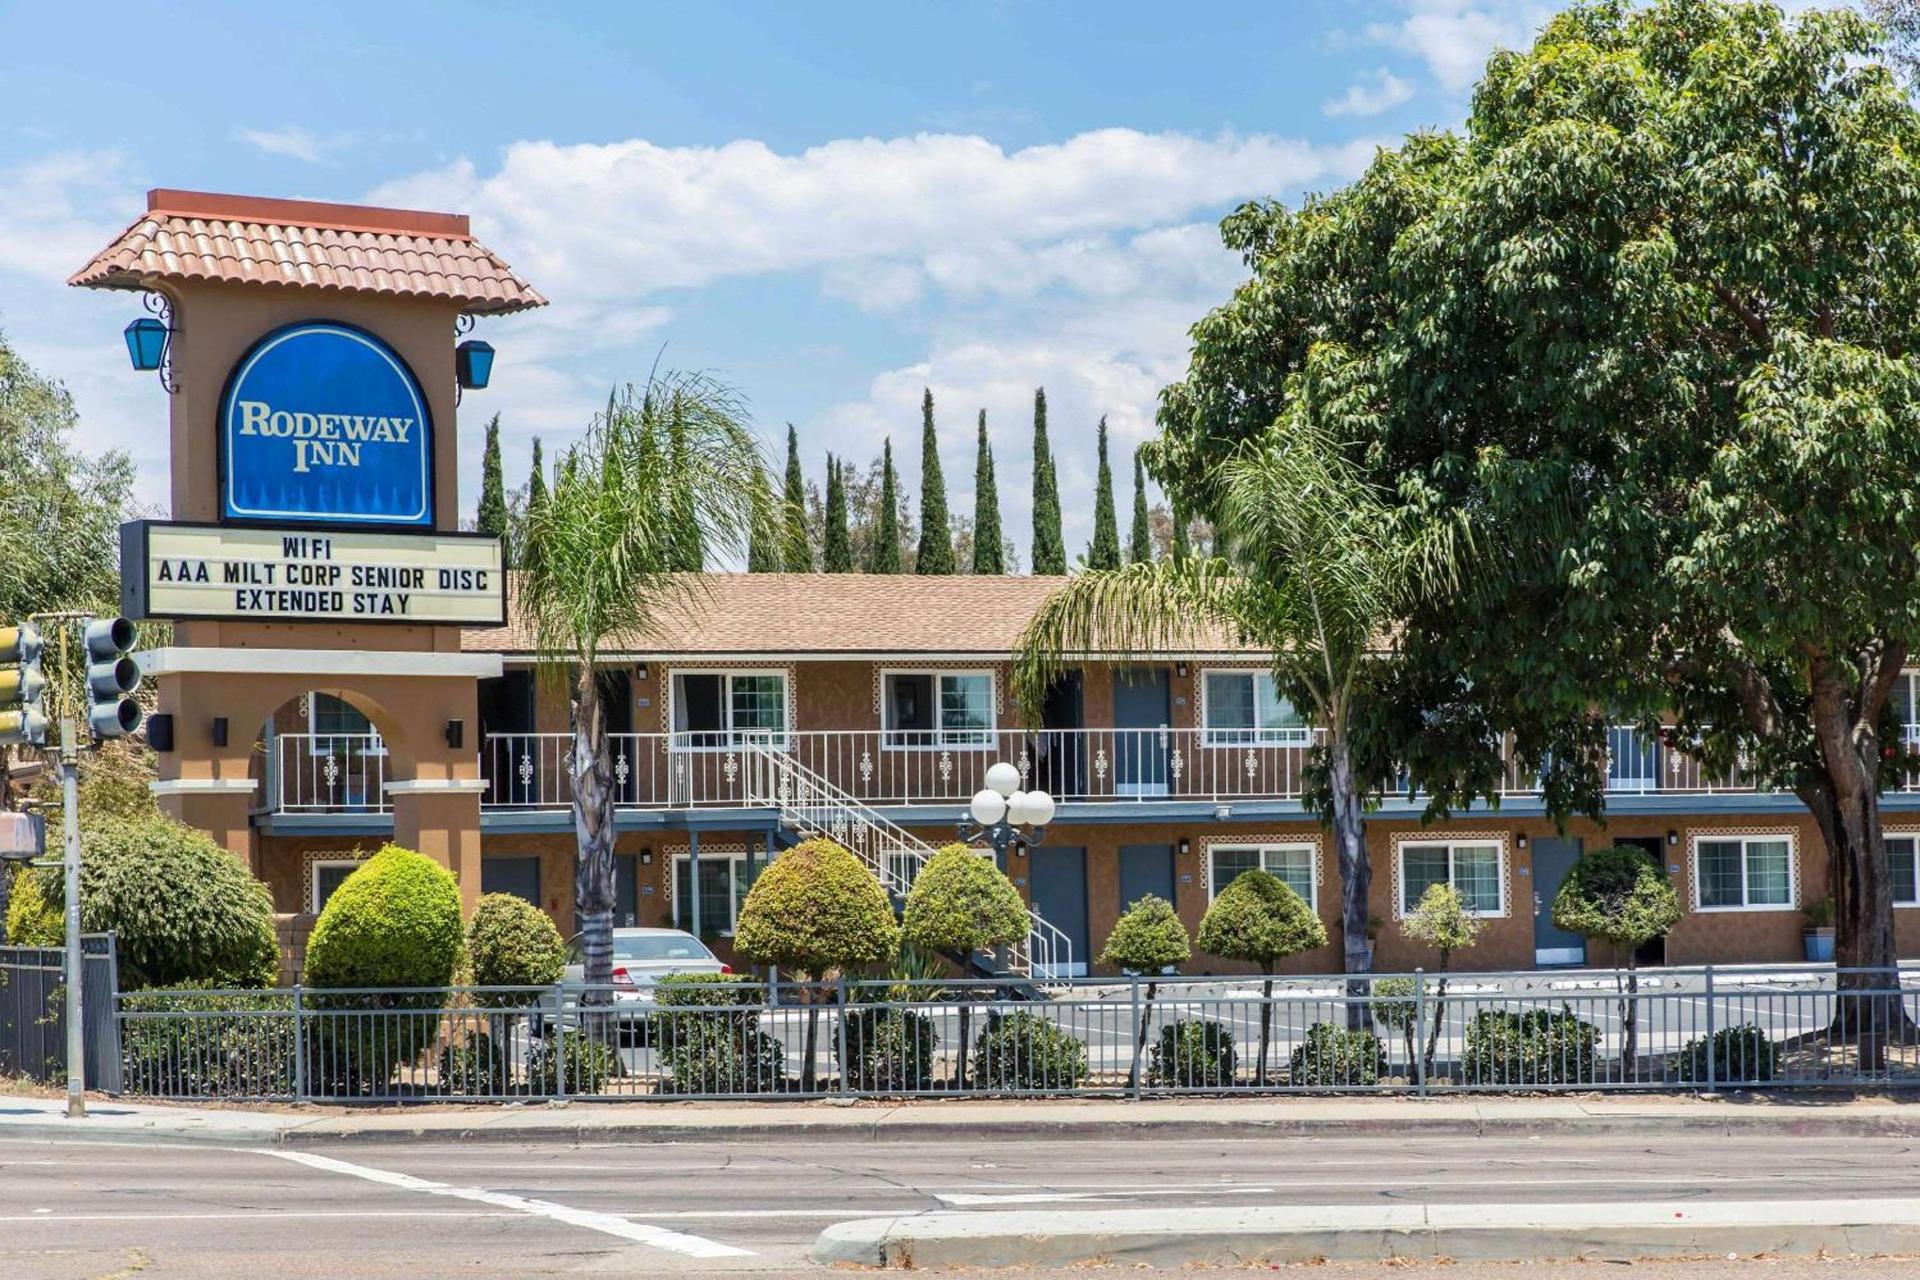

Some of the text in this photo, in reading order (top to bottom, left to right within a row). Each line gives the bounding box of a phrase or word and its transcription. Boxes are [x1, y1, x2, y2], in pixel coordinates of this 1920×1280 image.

[239, 401, 413, 443] RODEWAY
[293, 440, 362, 472] INN
[283, 537, 331, 560] WIFI
[158, 560, 488, 590] AAA MILT CORP SENIOR DISC
[236, 589, 409, 614] EXTENDED STAY
